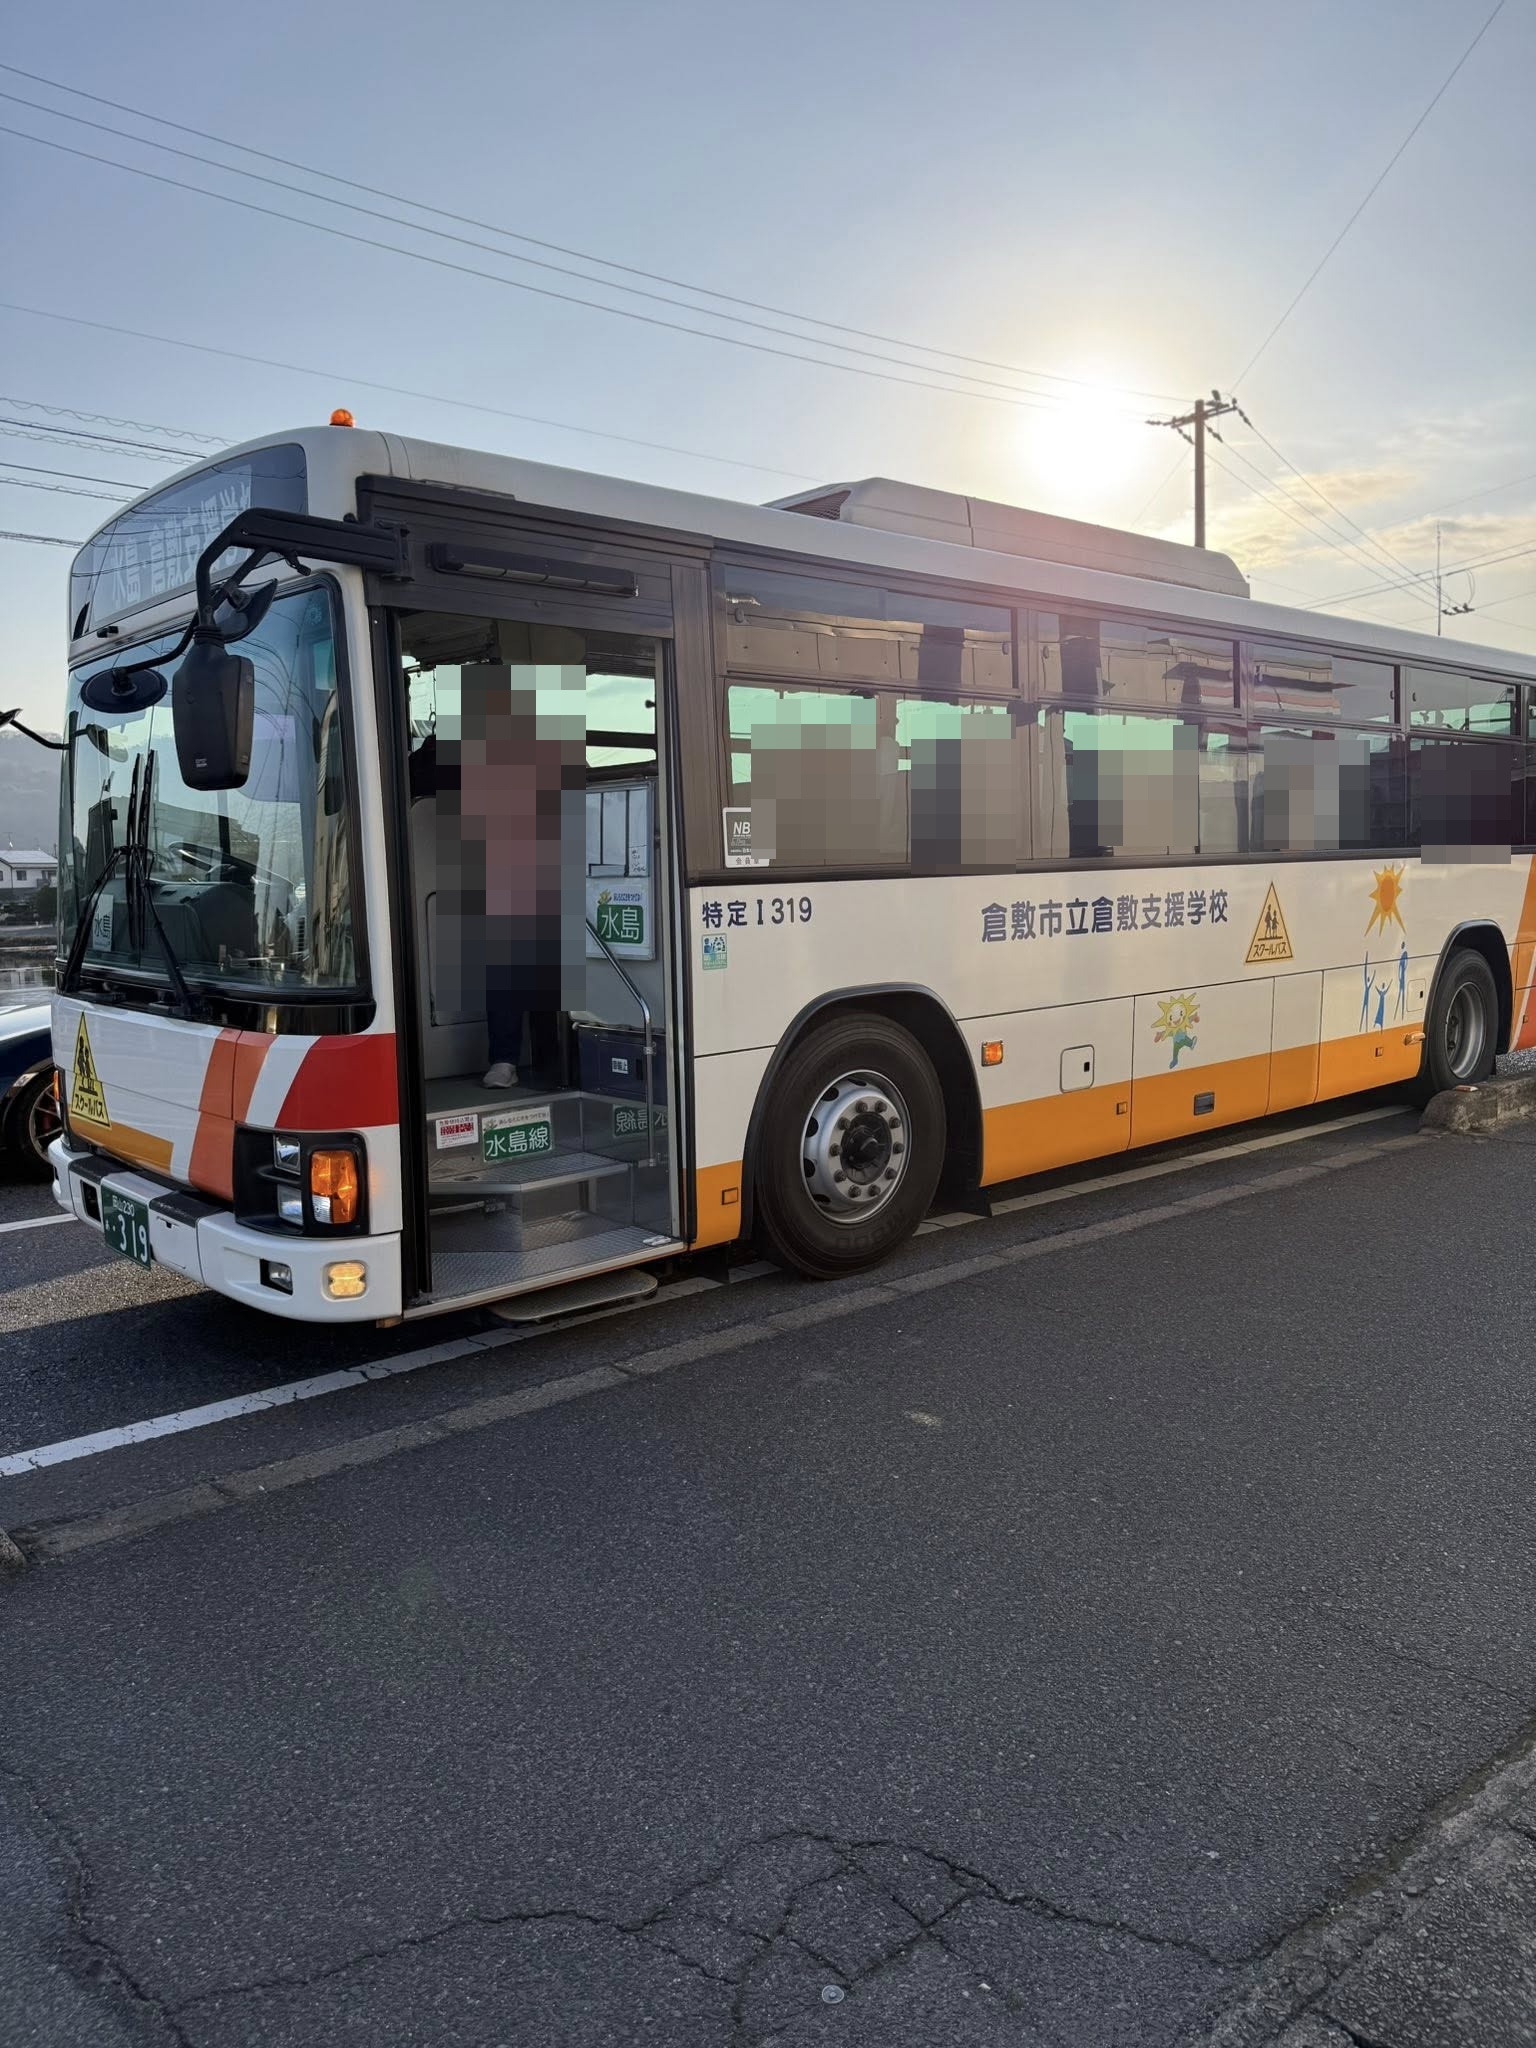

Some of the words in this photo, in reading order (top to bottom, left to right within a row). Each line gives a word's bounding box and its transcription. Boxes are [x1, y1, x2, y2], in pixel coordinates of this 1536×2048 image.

[600, 906, 640, 940] 水島
[702, 900, 748, 929] 特定
[981, 888, 1229, 943] 倉敷市立倉敷支援学校
[1253, 941, 1287, 958] スクールバス
[74, 1093, 105, 1119] スクールバス
[486, 1126, 549, 1157] 水島線
